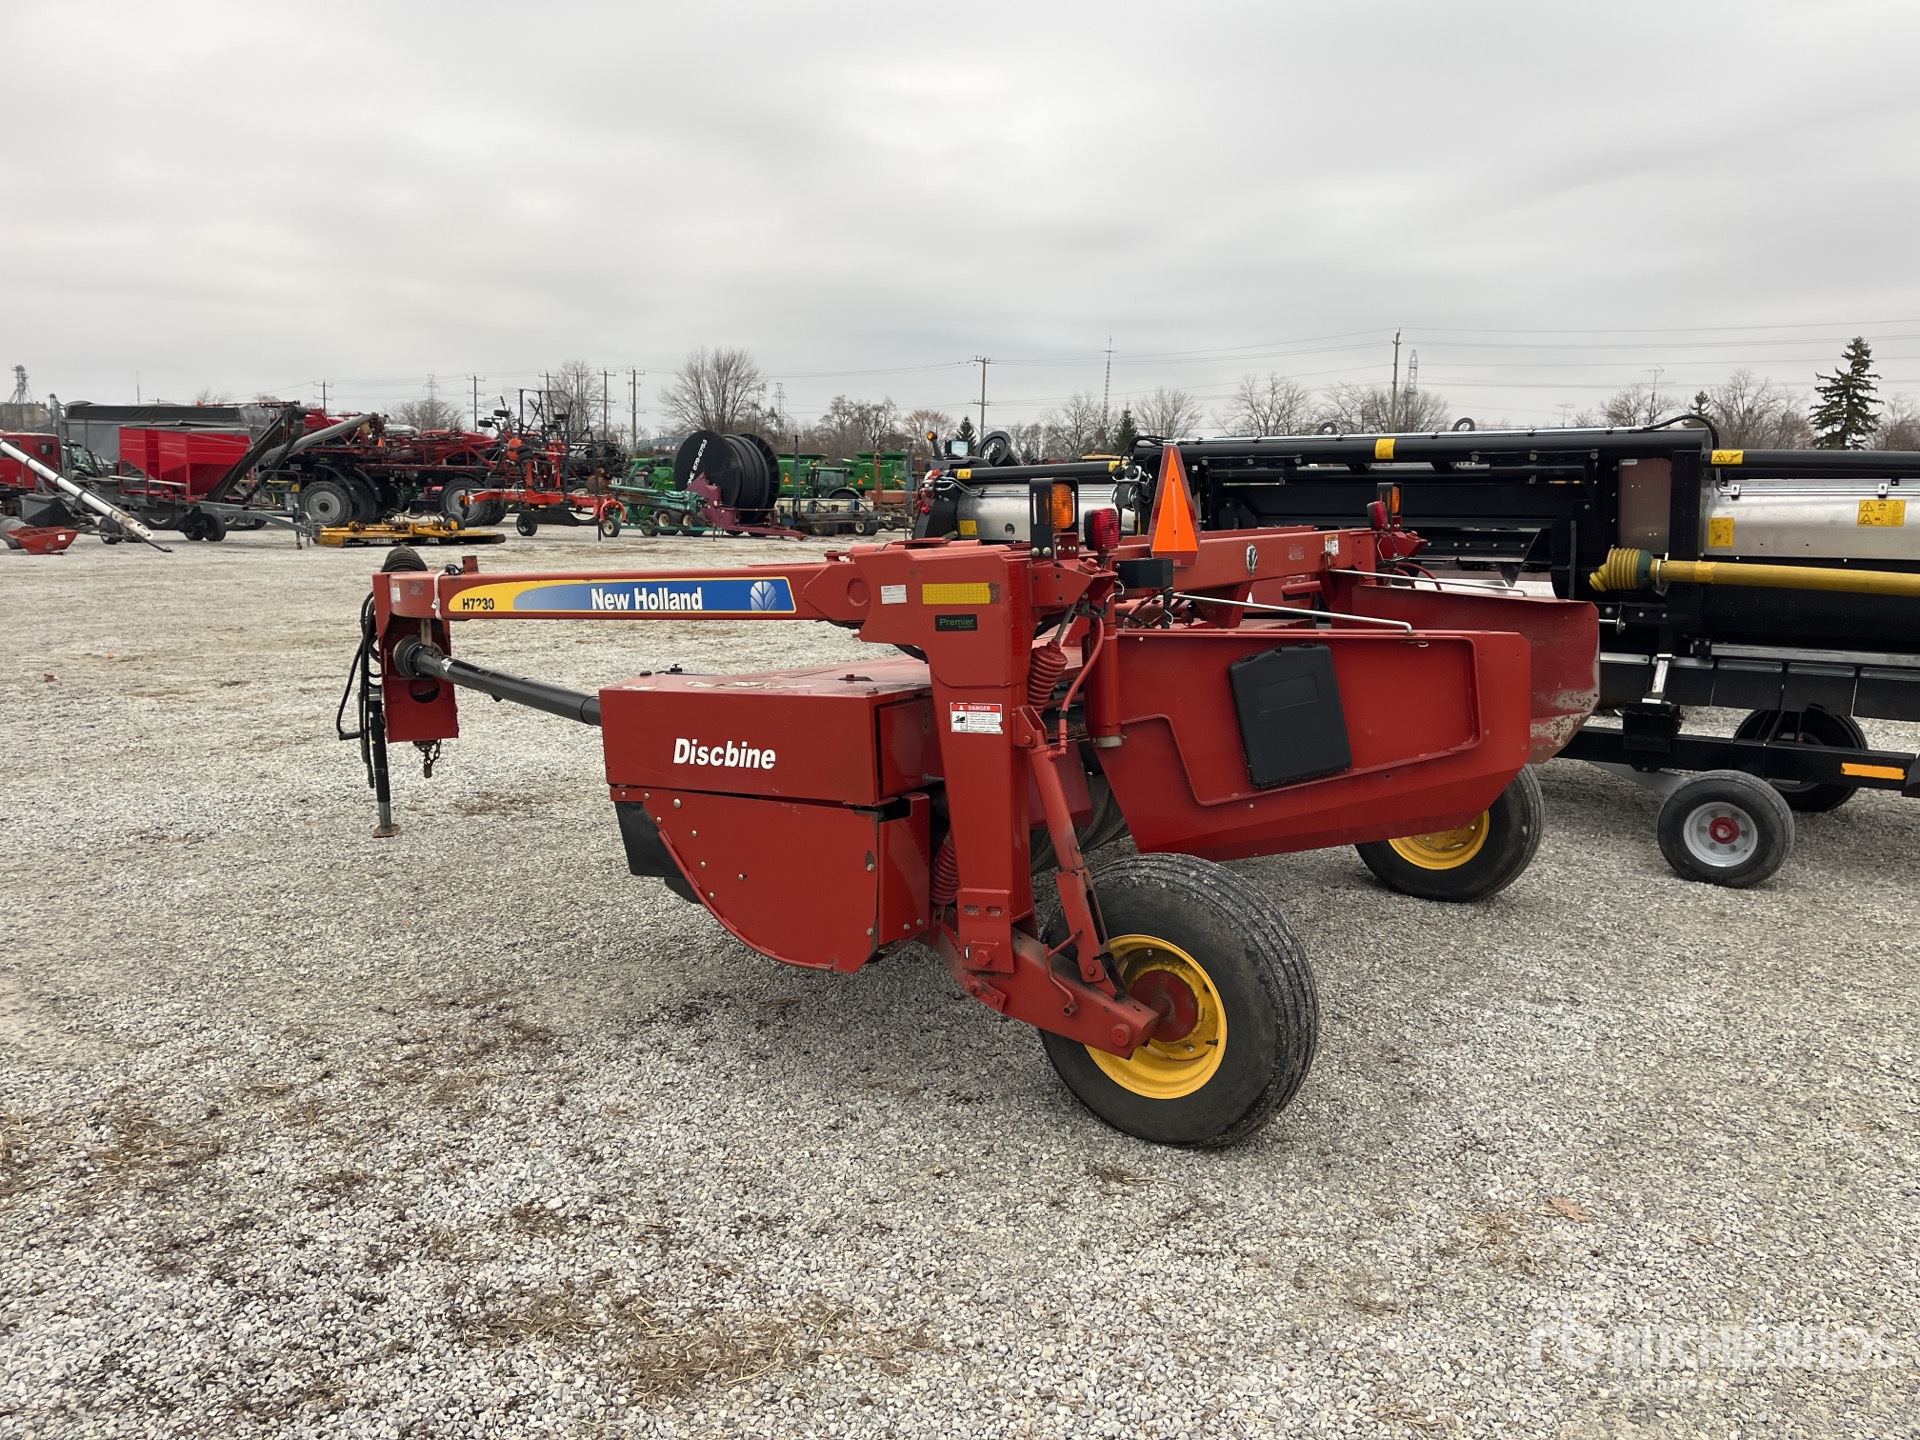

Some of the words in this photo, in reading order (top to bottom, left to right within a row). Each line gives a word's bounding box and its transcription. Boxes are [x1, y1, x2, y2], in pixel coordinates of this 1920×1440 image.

[590, 588, 629, 610] New
[634, 587, 702, 611] Holland
[939, 617, 975, 626] Premier
[673, 737, 776, 770] Discbine
